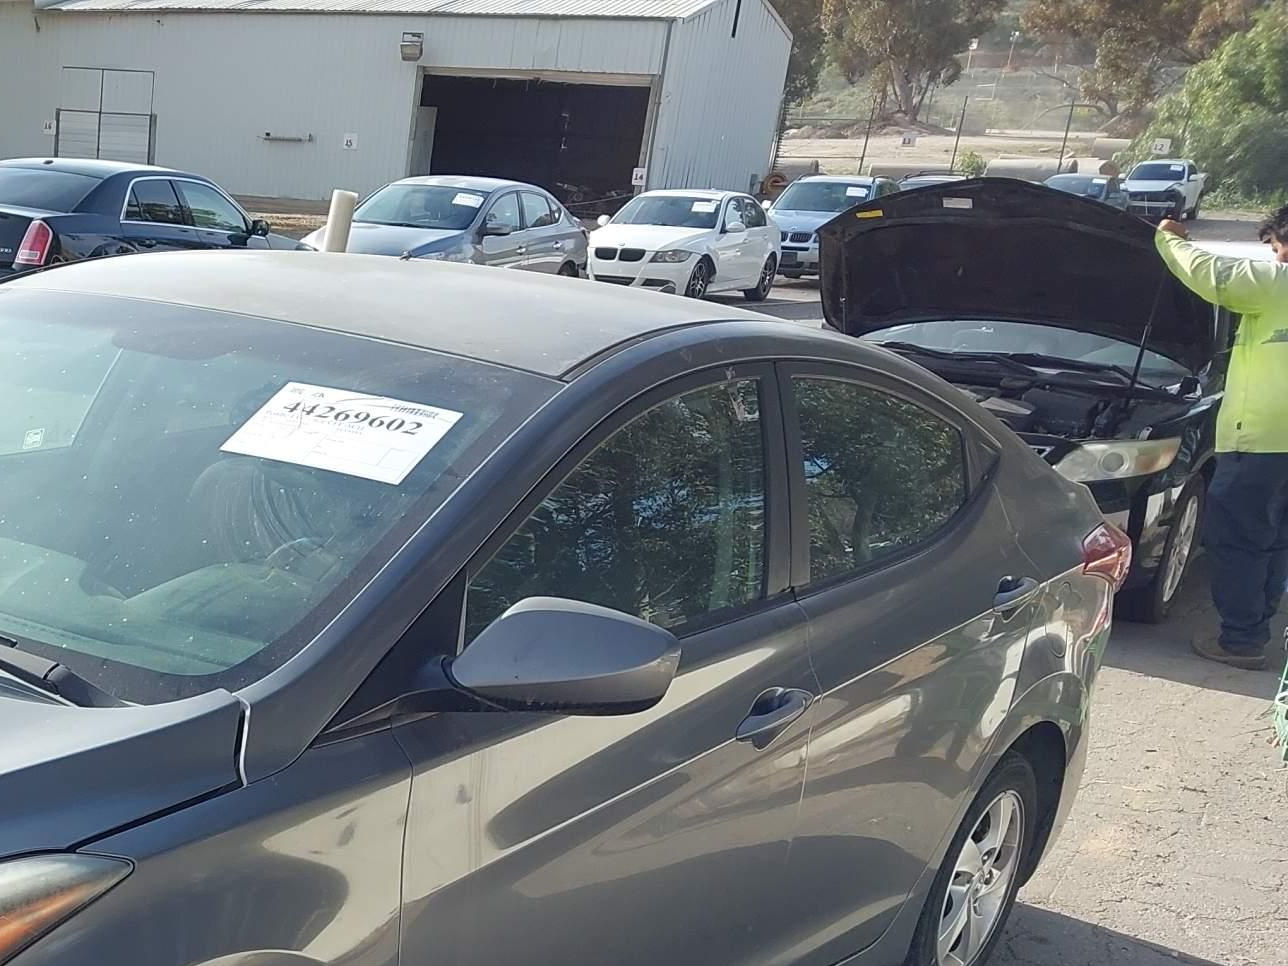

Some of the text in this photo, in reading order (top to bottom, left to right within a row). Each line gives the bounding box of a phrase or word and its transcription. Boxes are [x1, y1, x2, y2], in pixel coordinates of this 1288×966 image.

[344, 138, 353, 148] 15
[1153, 143, 1165, 152] 12
[633, 173, 644, 181] 14
[283, 400, 423, 436] 44269602
